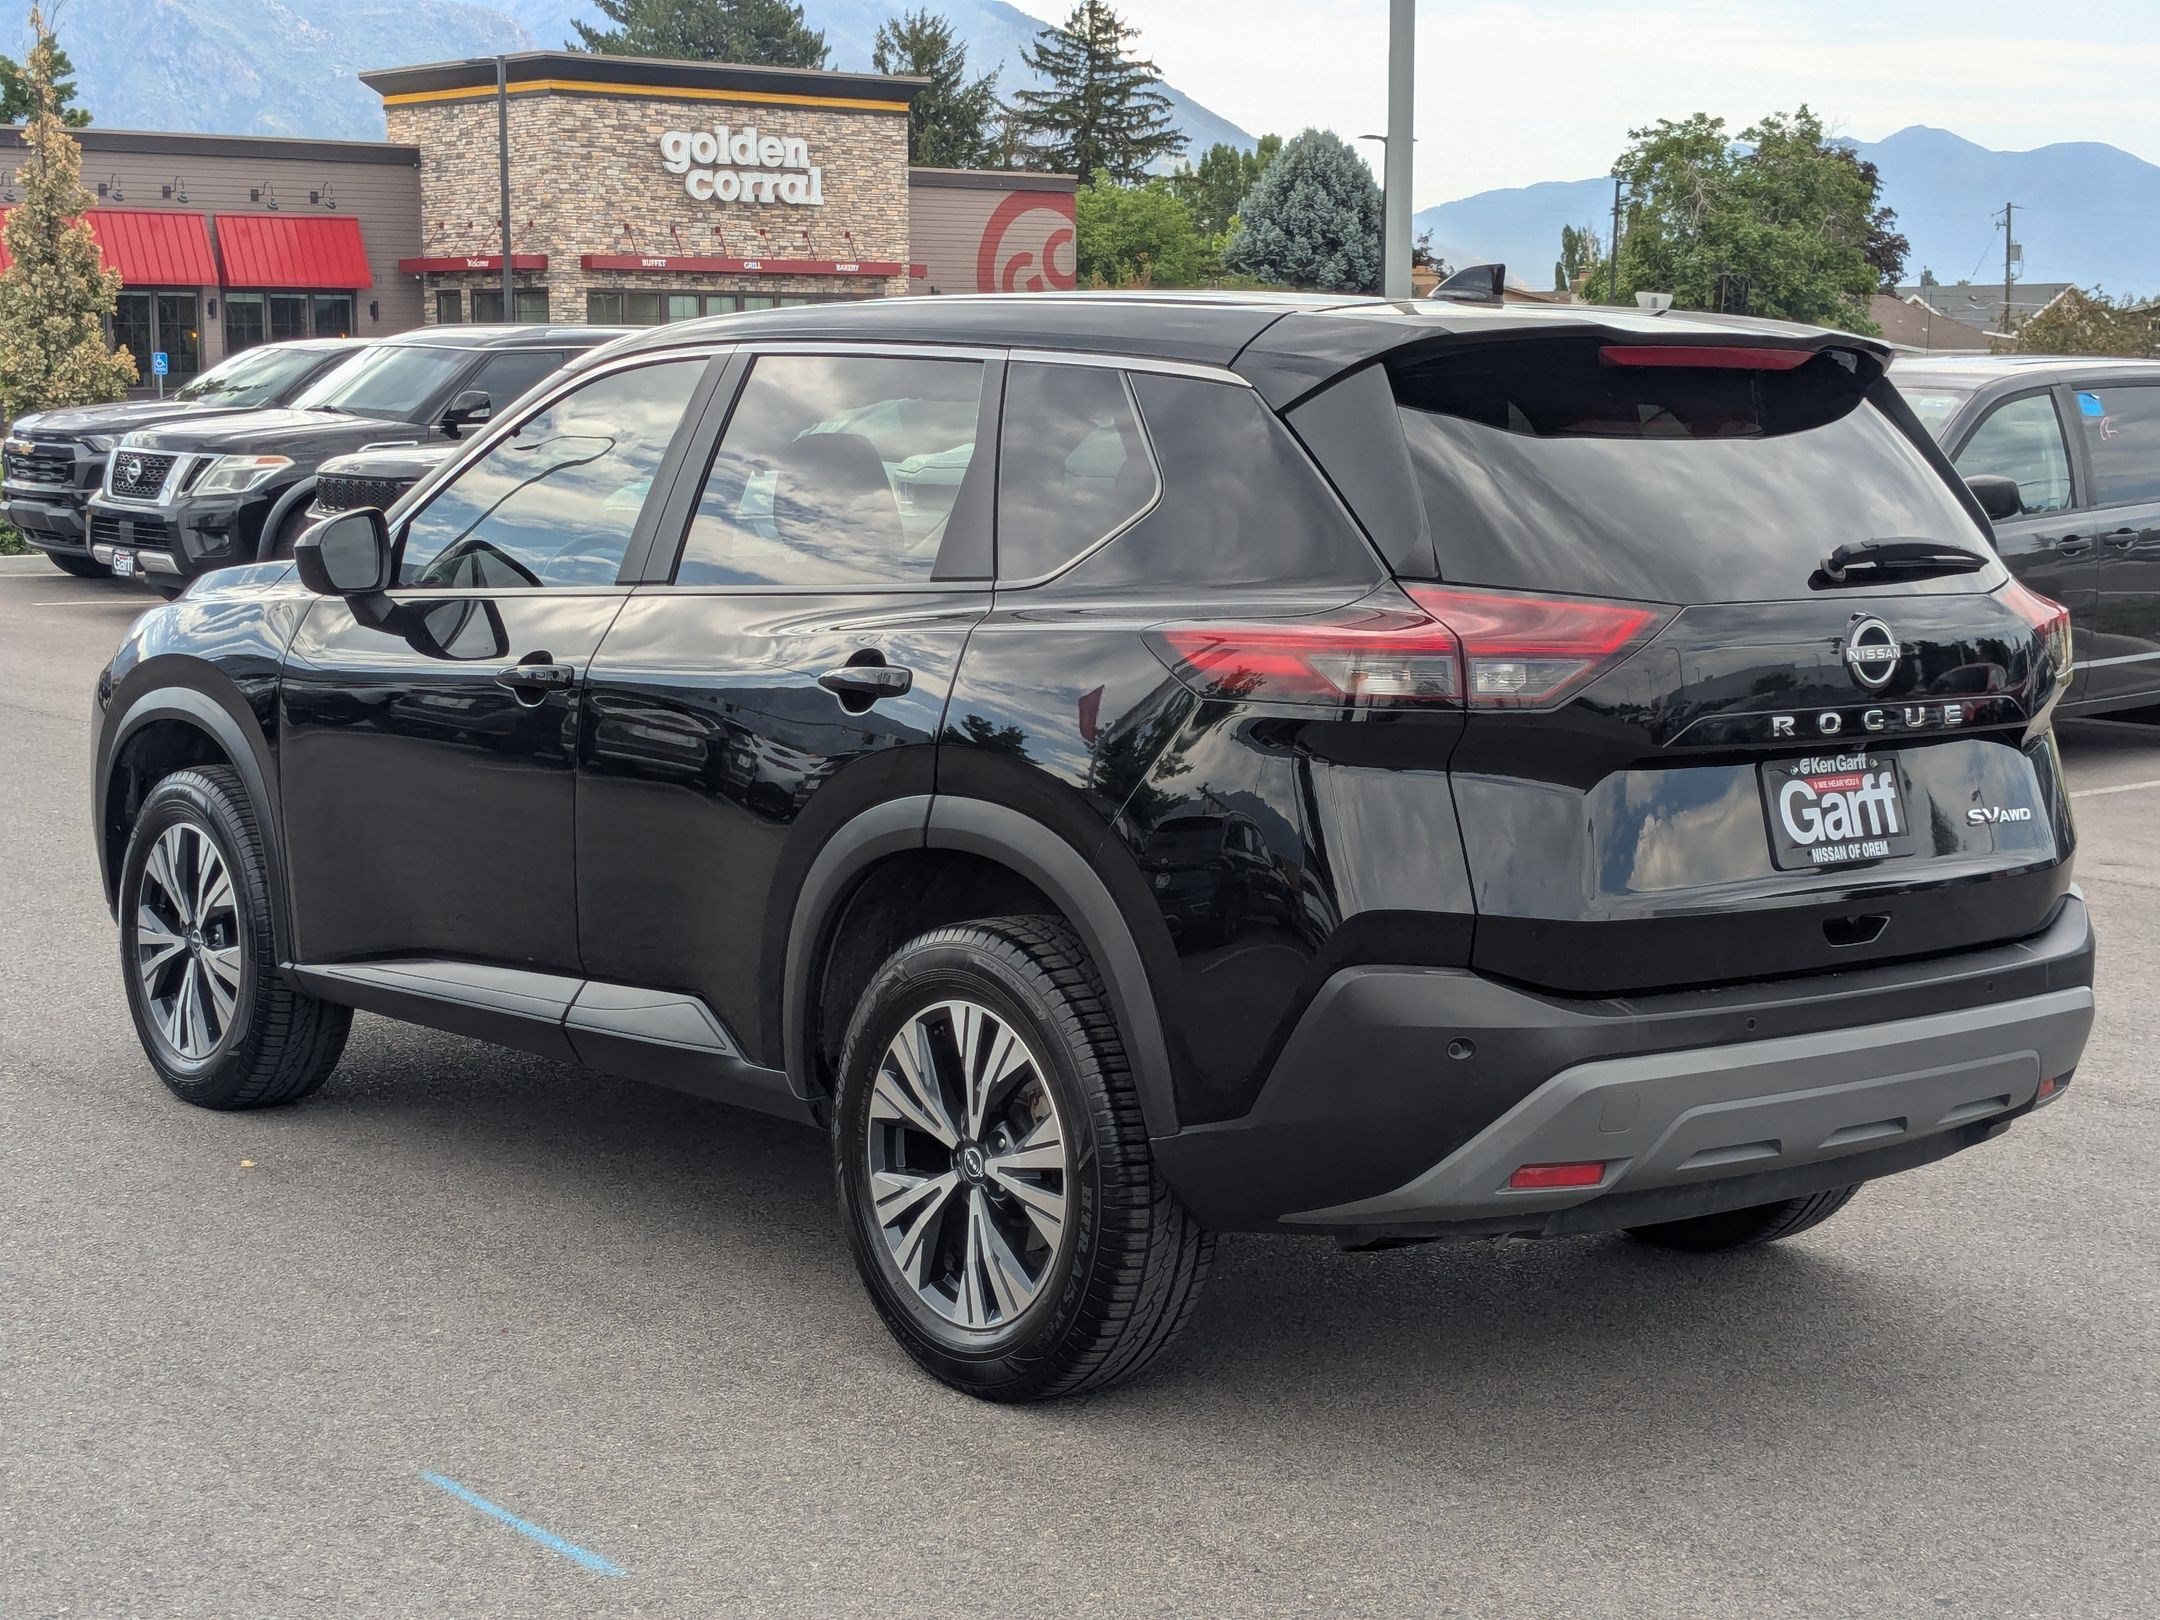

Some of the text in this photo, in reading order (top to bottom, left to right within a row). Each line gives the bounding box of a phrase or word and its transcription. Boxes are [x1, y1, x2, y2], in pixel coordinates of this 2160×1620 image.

[660, 125, 811, 174] golden
[685, 167, 824, 206] corral
[1848, 648, 1901, 661] NISSAN
[1771, 704, 1963, 737] ROGUE
[1779, 771, 1899, 845] Garff
[1966, 806, 2031, 826] SV AWD
[1811, 840, 1889, 863] NISSAN OF OREM
